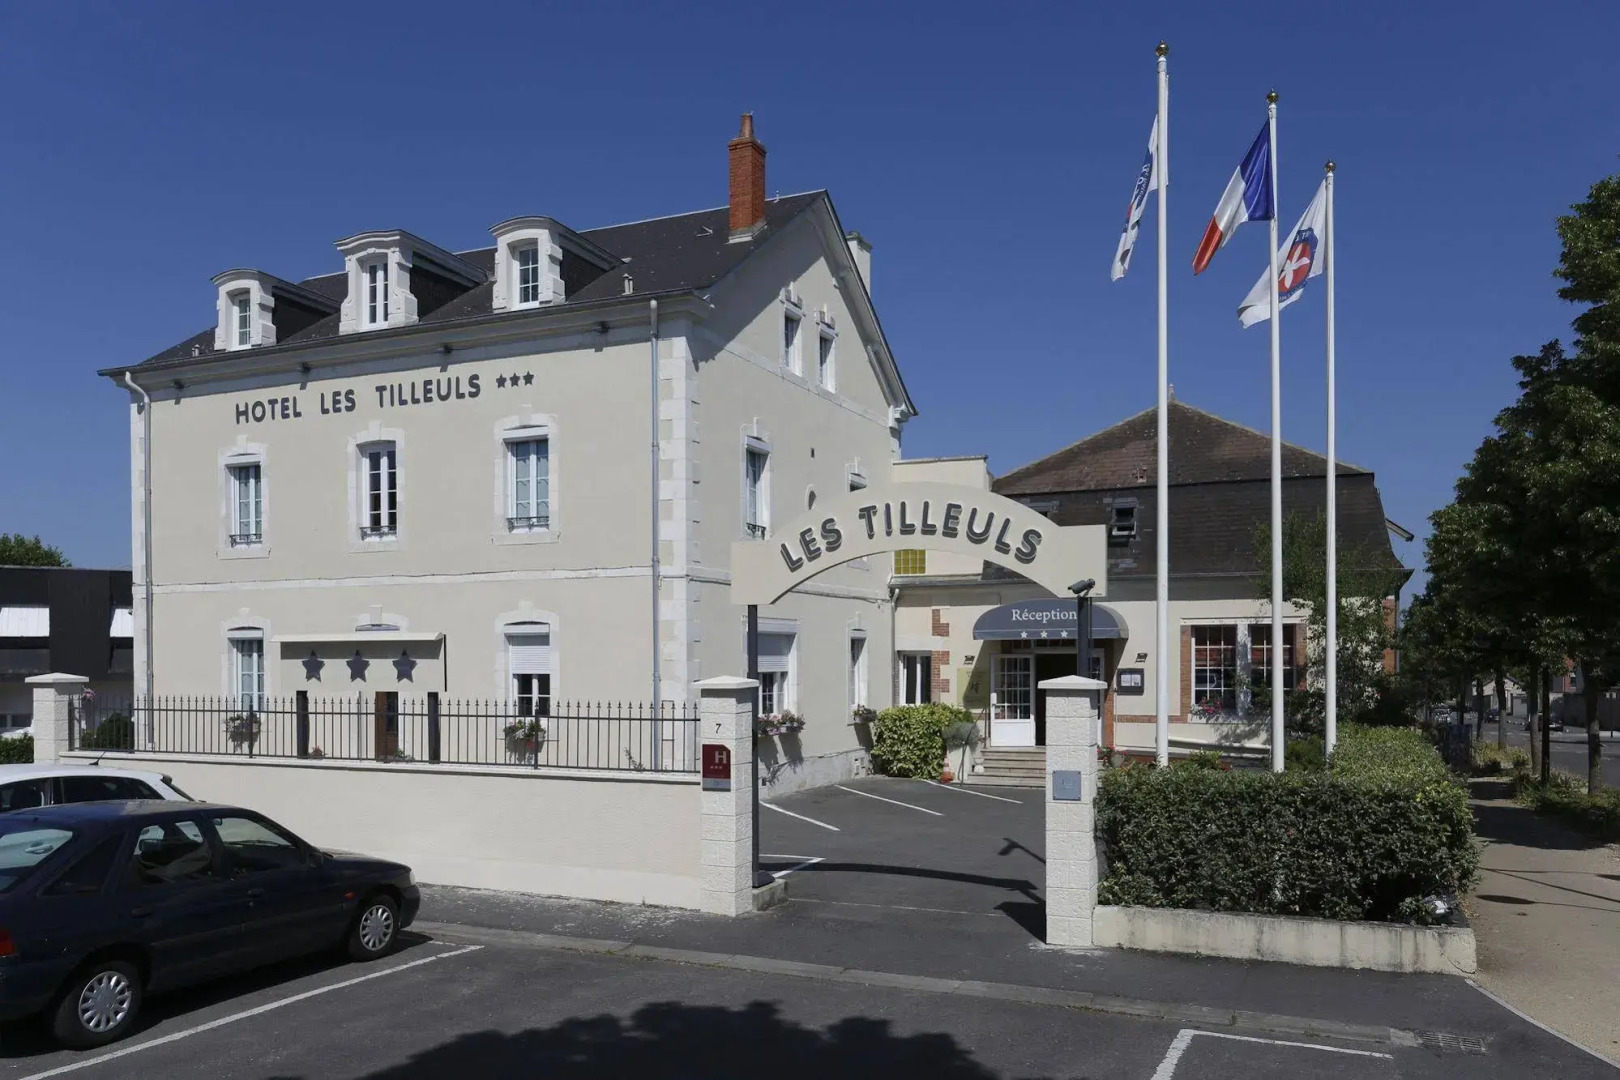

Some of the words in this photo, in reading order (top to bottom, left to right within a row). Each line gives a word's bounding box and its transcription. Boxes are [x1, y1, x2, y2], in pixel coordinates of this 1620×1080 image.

[235, 396, 302, 425] HOTEL
[320, 389, 356, 415] LES
[375, 374, 481, 408] TILLEULS
[780, 517, 842, 573] LES
[858, 500, 1043, 564] TILLEULS
[1011, 608, 1078, 624] Réception
[715, 723, 722, 734] 7
[714, 750, 727, 764] H
